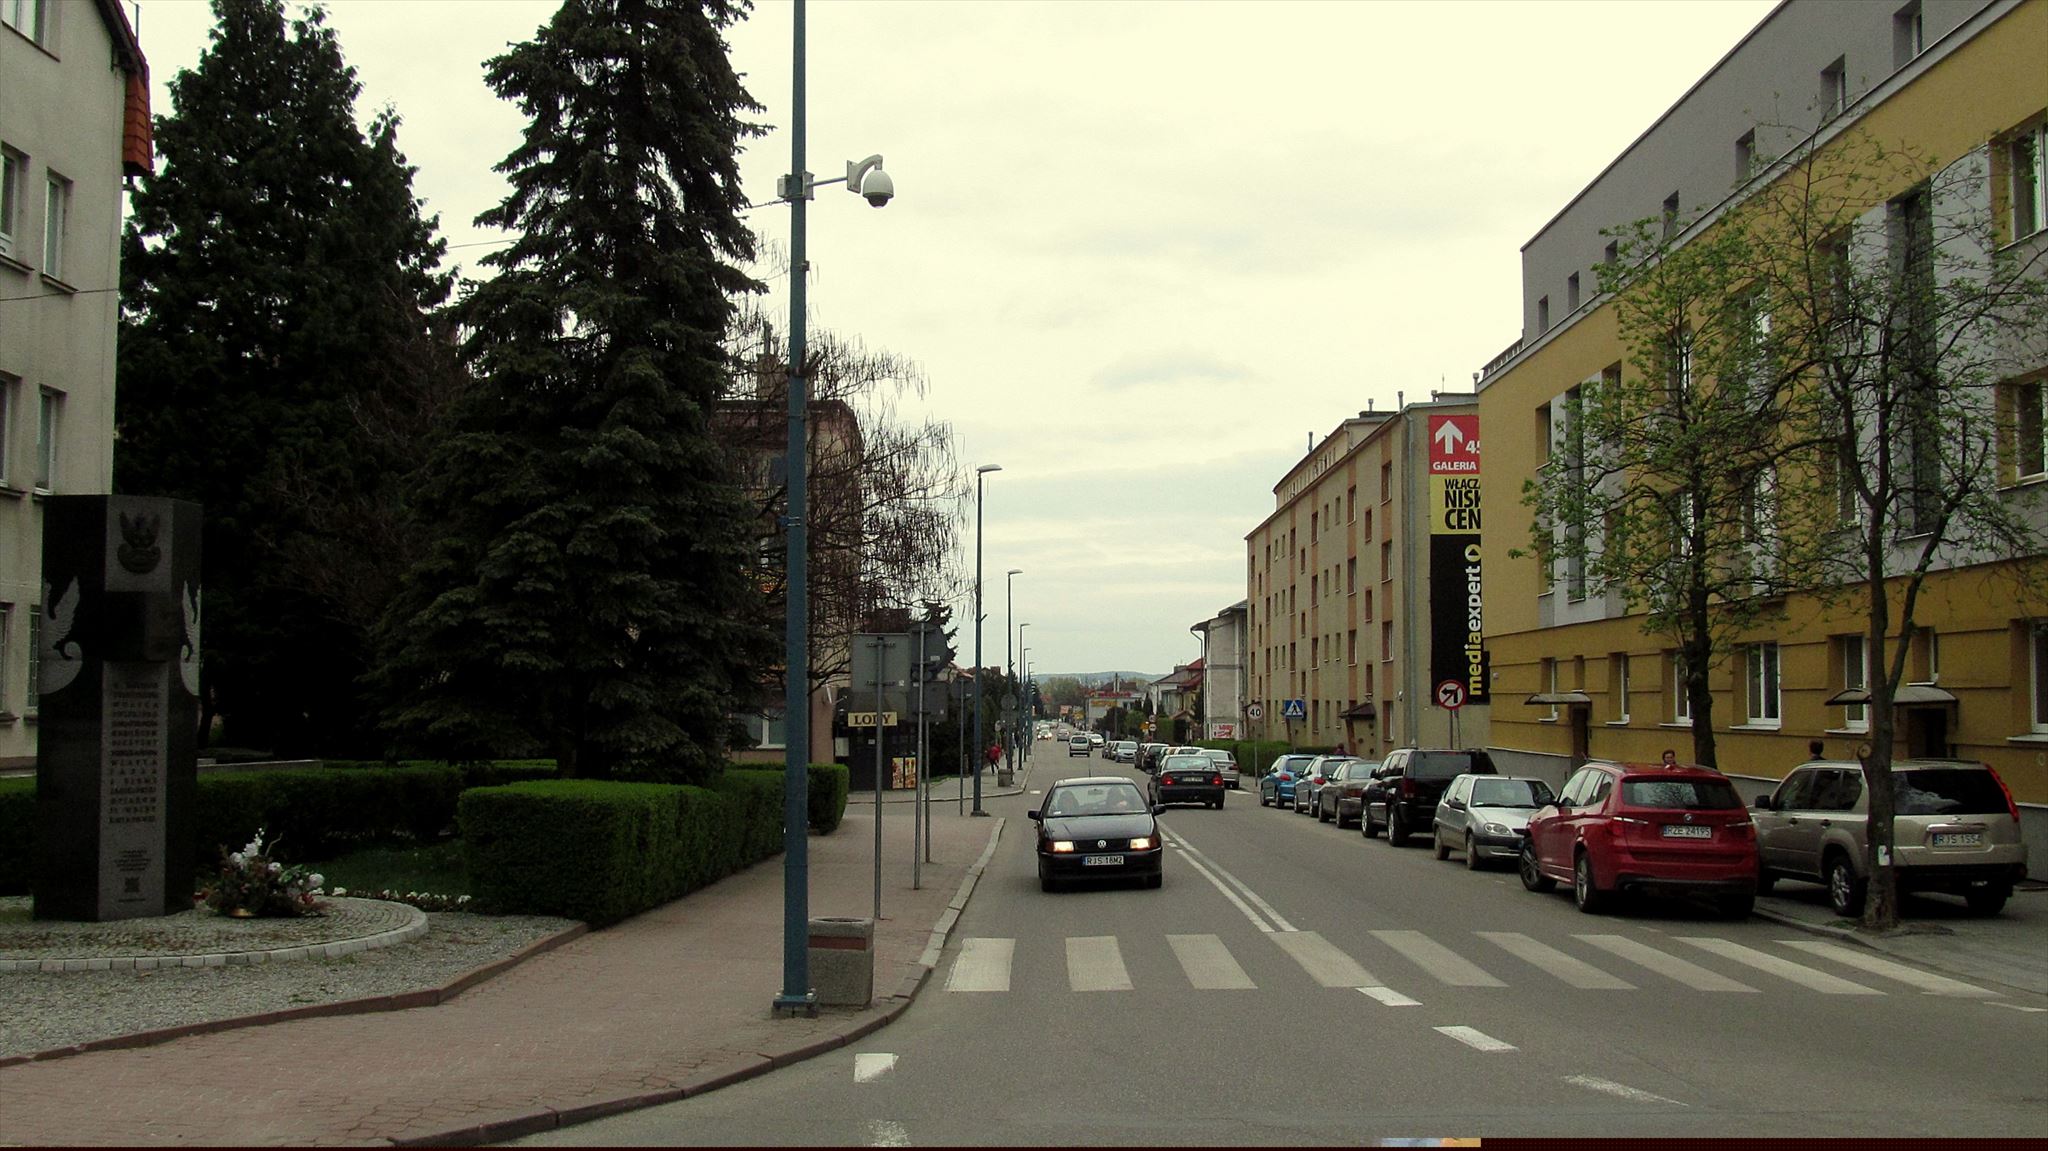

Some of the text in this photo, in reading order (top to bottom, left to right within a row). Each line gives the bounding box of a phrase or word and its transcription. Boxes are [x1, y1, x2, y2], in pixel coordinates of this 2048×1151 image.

[1432, 461, 1477, 471] GALERIA
[1464, 565, 1482, 696] mediaexpert
[1249, 708, 1261, 717] 40
[1086, 856, 1103, 865] RJS
